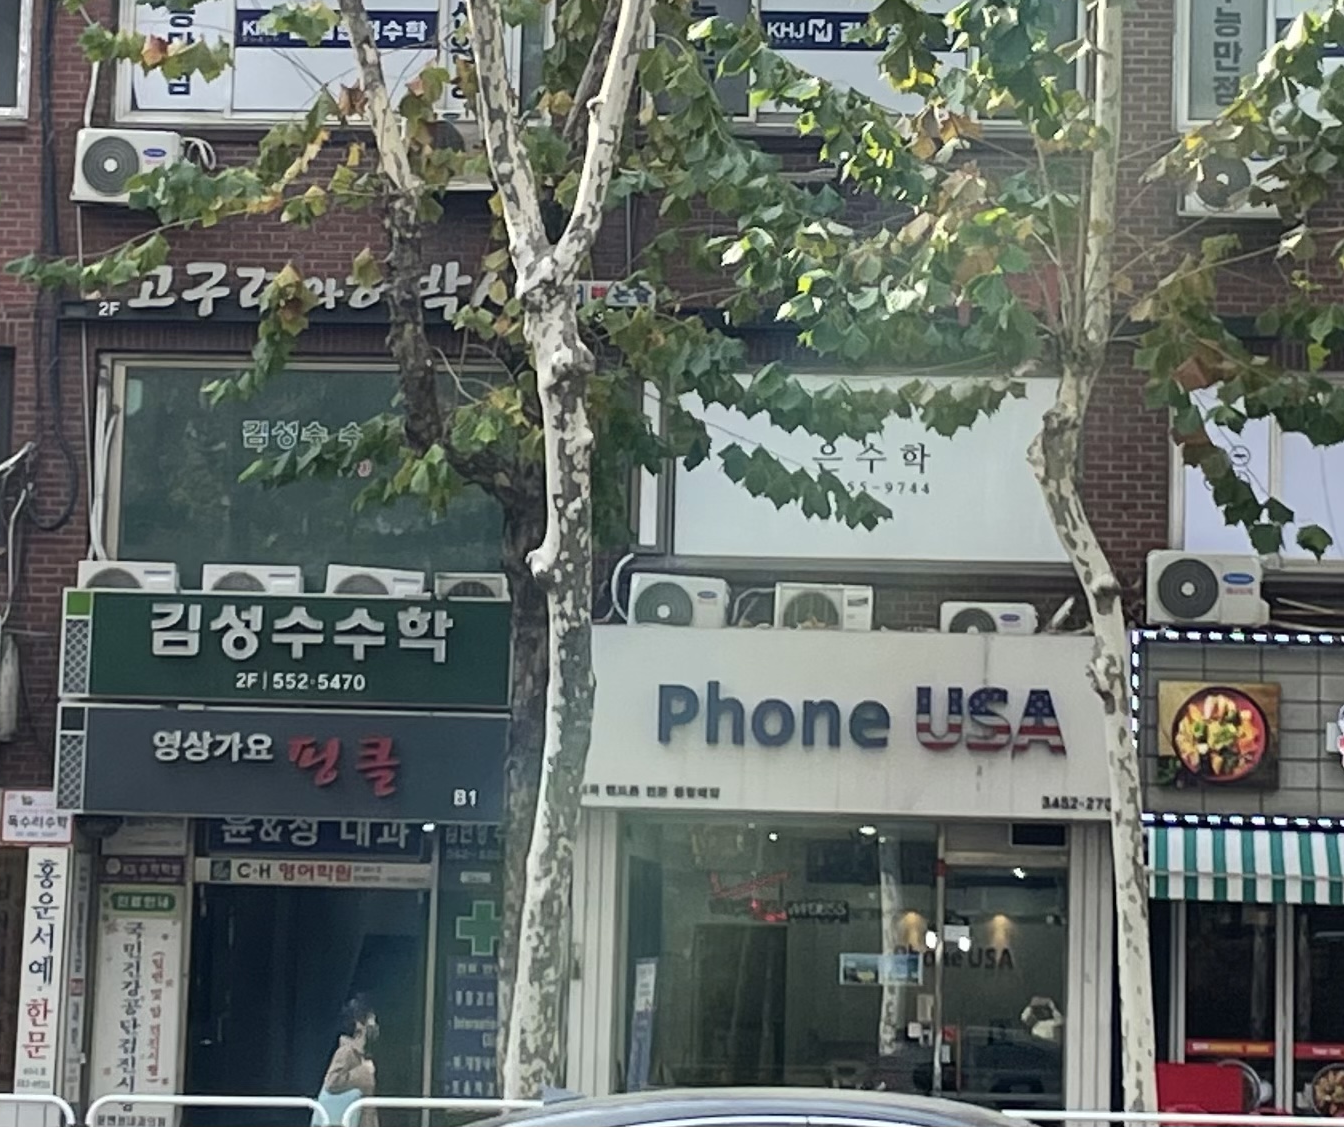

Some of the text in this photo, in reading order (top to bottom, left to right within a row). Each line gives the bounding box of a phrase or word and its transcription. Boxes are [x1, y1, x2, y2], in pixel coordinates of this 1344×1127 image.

[767, 21, 806, 40] KHJ
[99, 302, 120, 317] 2F
[847, 481, 931, 495] 55-9744
[150, 602, 453, 663] 김성수수학
[657, 680, 1068, 758] Phone USA
[152, 732, 274, 763] 영상가요
[453, 788, 478, 806] B1
